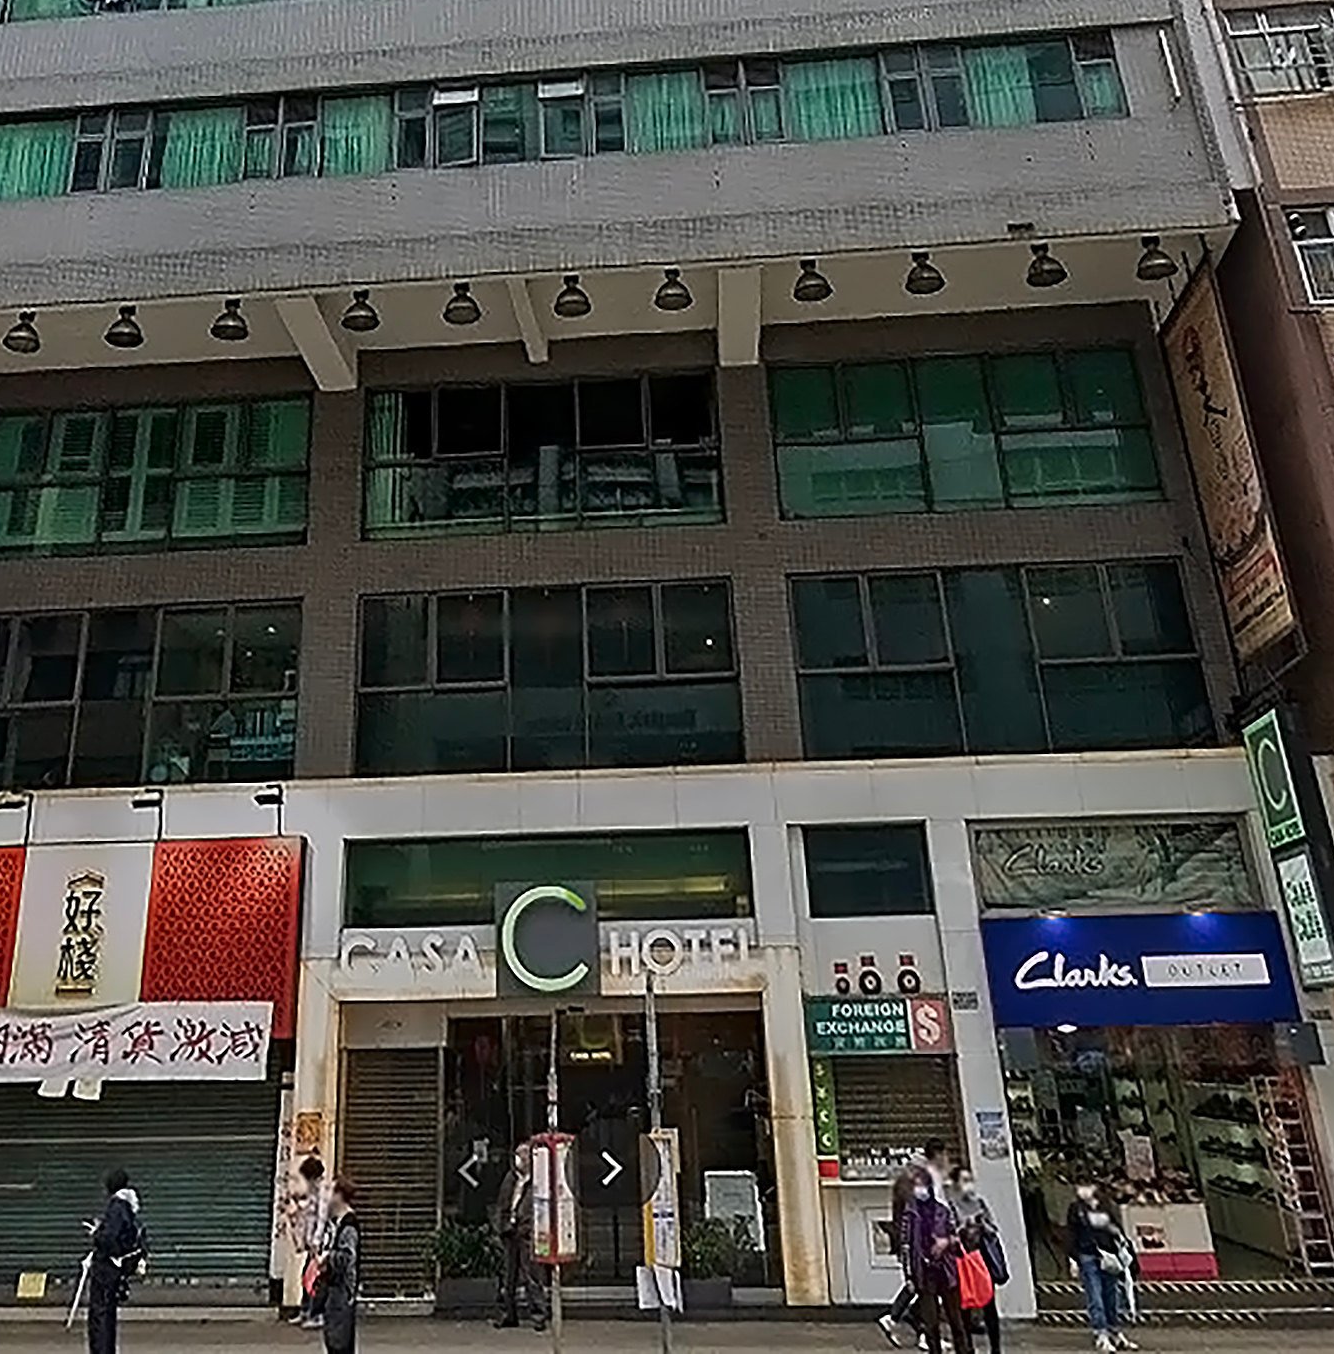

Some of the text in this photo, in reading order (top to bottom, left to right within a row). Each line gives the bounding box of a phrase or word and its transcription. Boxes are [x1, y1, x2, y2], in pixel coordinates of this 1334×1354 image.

[339, 885, 750, 993] CASA C HOTEL
[831, 1002, 905, 1018] FOREIGN
[816, 1020, 907, 1036] EXCHANGE
